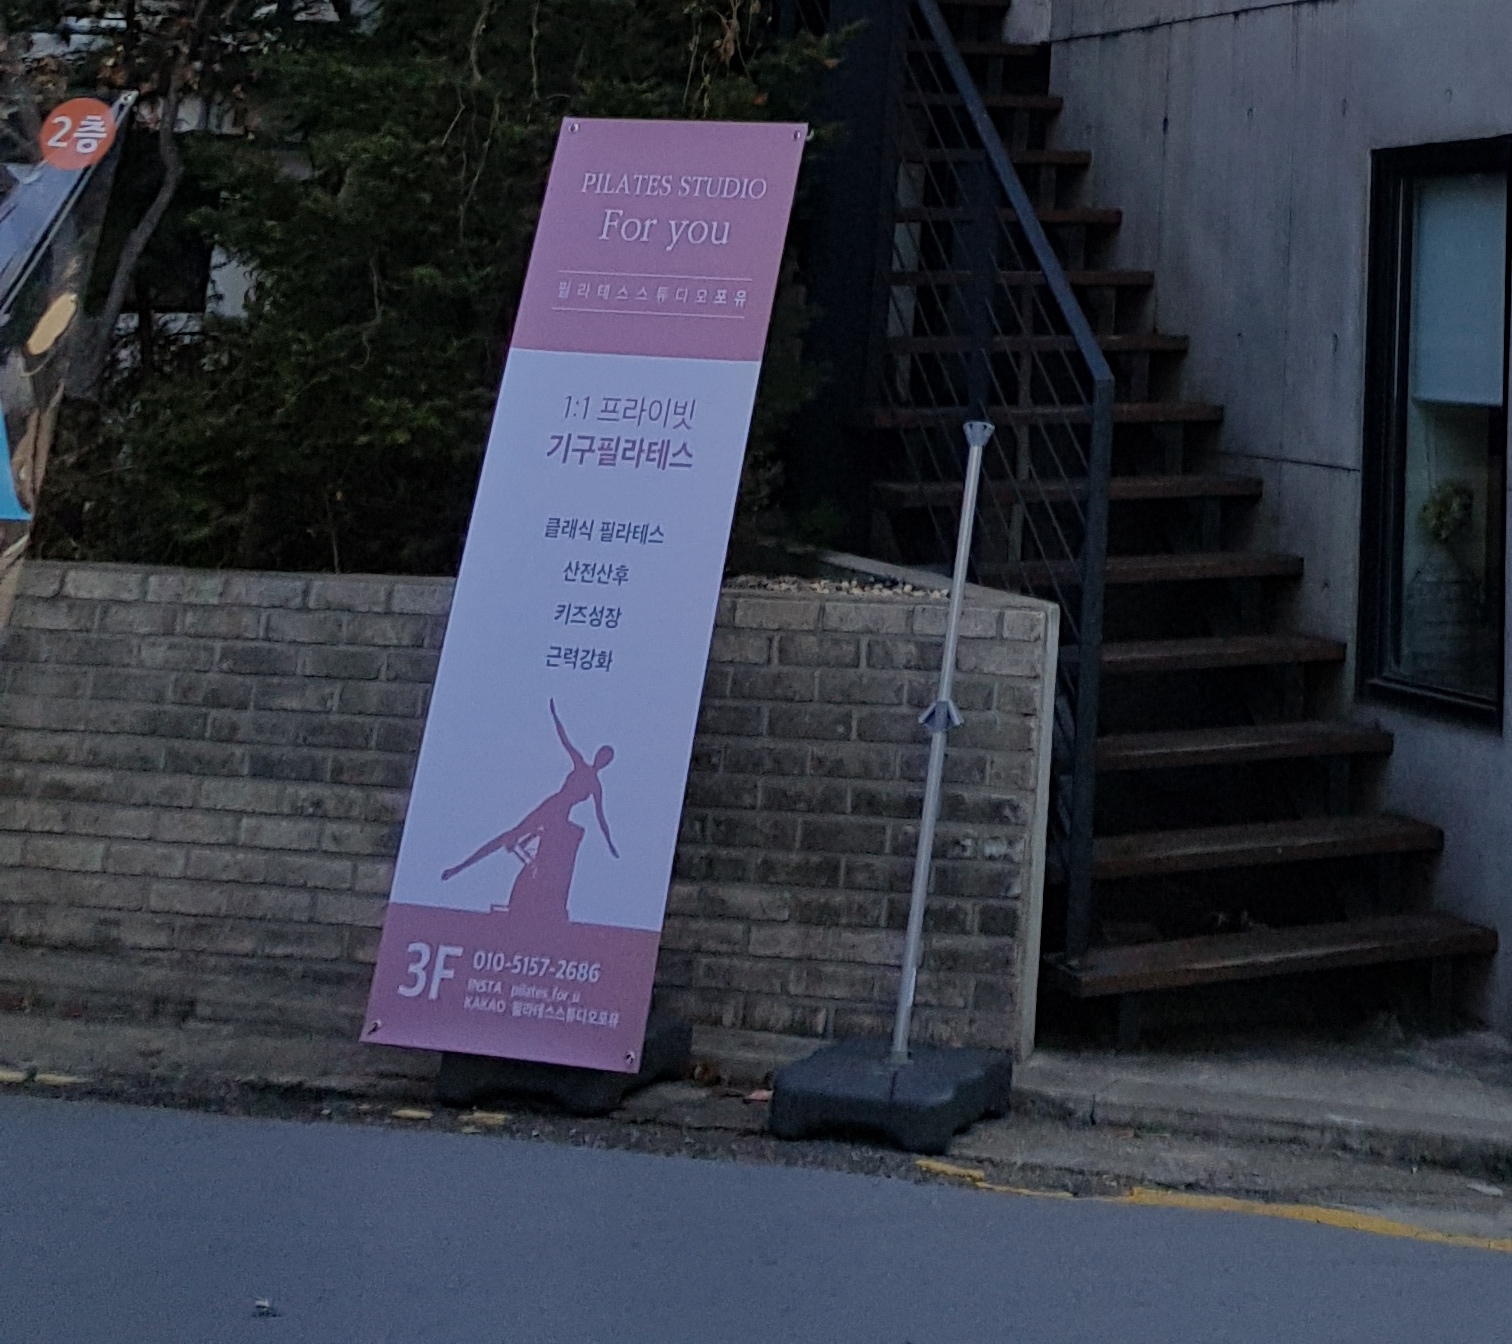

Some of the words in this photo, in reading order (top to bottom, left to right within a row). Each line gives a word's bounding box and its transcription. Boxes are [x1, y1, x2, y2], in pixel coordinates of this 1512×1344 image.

[47, 115, 107, 154] 2층
[581, 172, 673, 197] PILATES
[677, 175, 767, 200] STUDIO
[599, 208, 657, 242] For
[666, 219, 730, 251] you
[563, 395, 591, 420] 1:1
[596, 396, 697, 430] 프라이빗
[546, 433, 694, 470] 기구필라테스
[544, 516, 595, 541] 클래식
[599, 520, 665, 544] 필라테스
[563, 560, 630, 586] 산전산후
[553, 603, 622, 629] 키즈성장
[545, 645, 613, 672] 근력강화
[397, 941, 464, 1001] 3F
[472, 950, 601, 983] 010-5157-2686
[463, 995, 506, 1013] KAKAO
